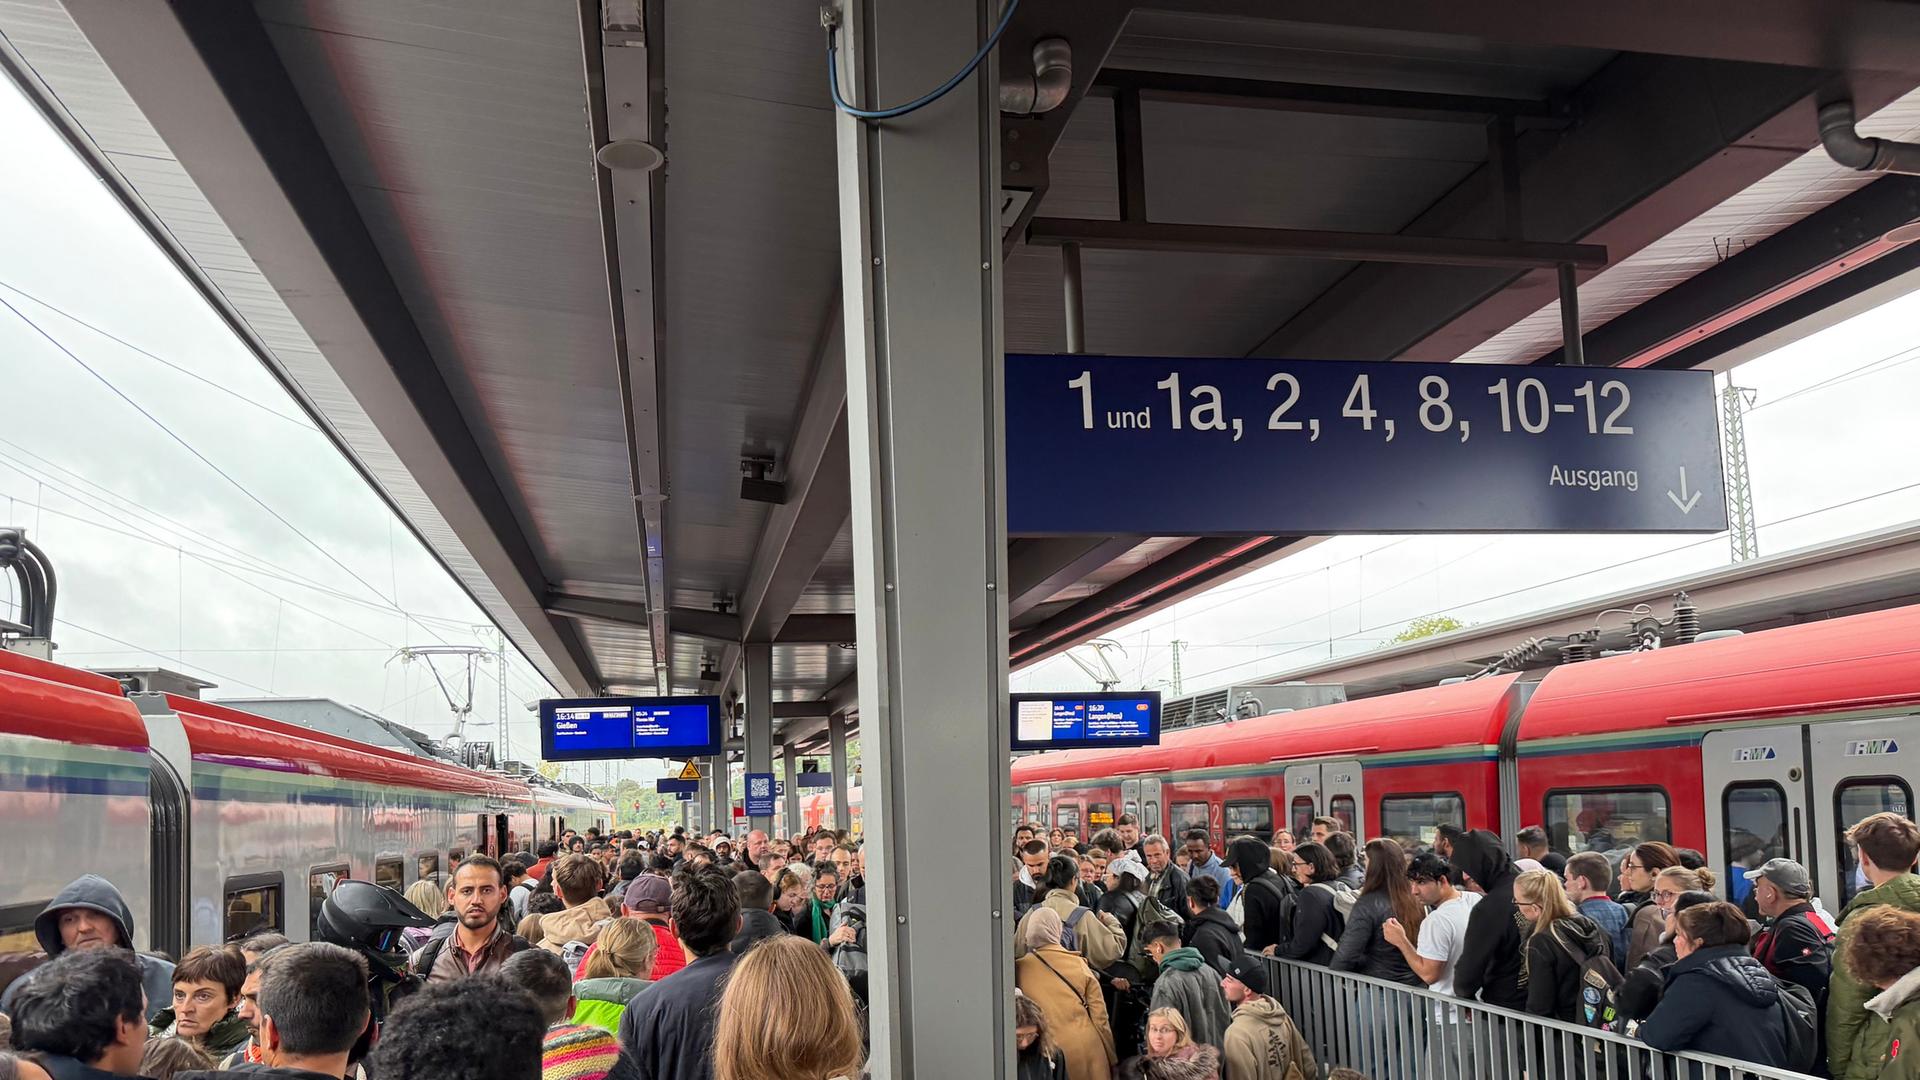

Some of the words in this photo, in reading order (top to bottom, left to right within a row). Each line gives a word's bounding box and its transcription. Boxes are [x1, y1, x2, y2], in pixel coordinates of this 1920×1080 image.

[1068, 371, 1094, 429] 1
[1107, 406, 1151, 429] und
[1157, 372, 1243, 442] 1a,
[1266, 372, 1320, 442] 2,
[1342, 374, 1395, 442] 4,
[1418, 375, 1470, 443] 8,
[1487, 378, 1635, 437] 10-12
[1549, 464, 1639, 492] Ausgang
[556, 721, 578, 730] Gießen
[775, 782, 783, 793] 5
[1212, 803, 1221, 829] 2
